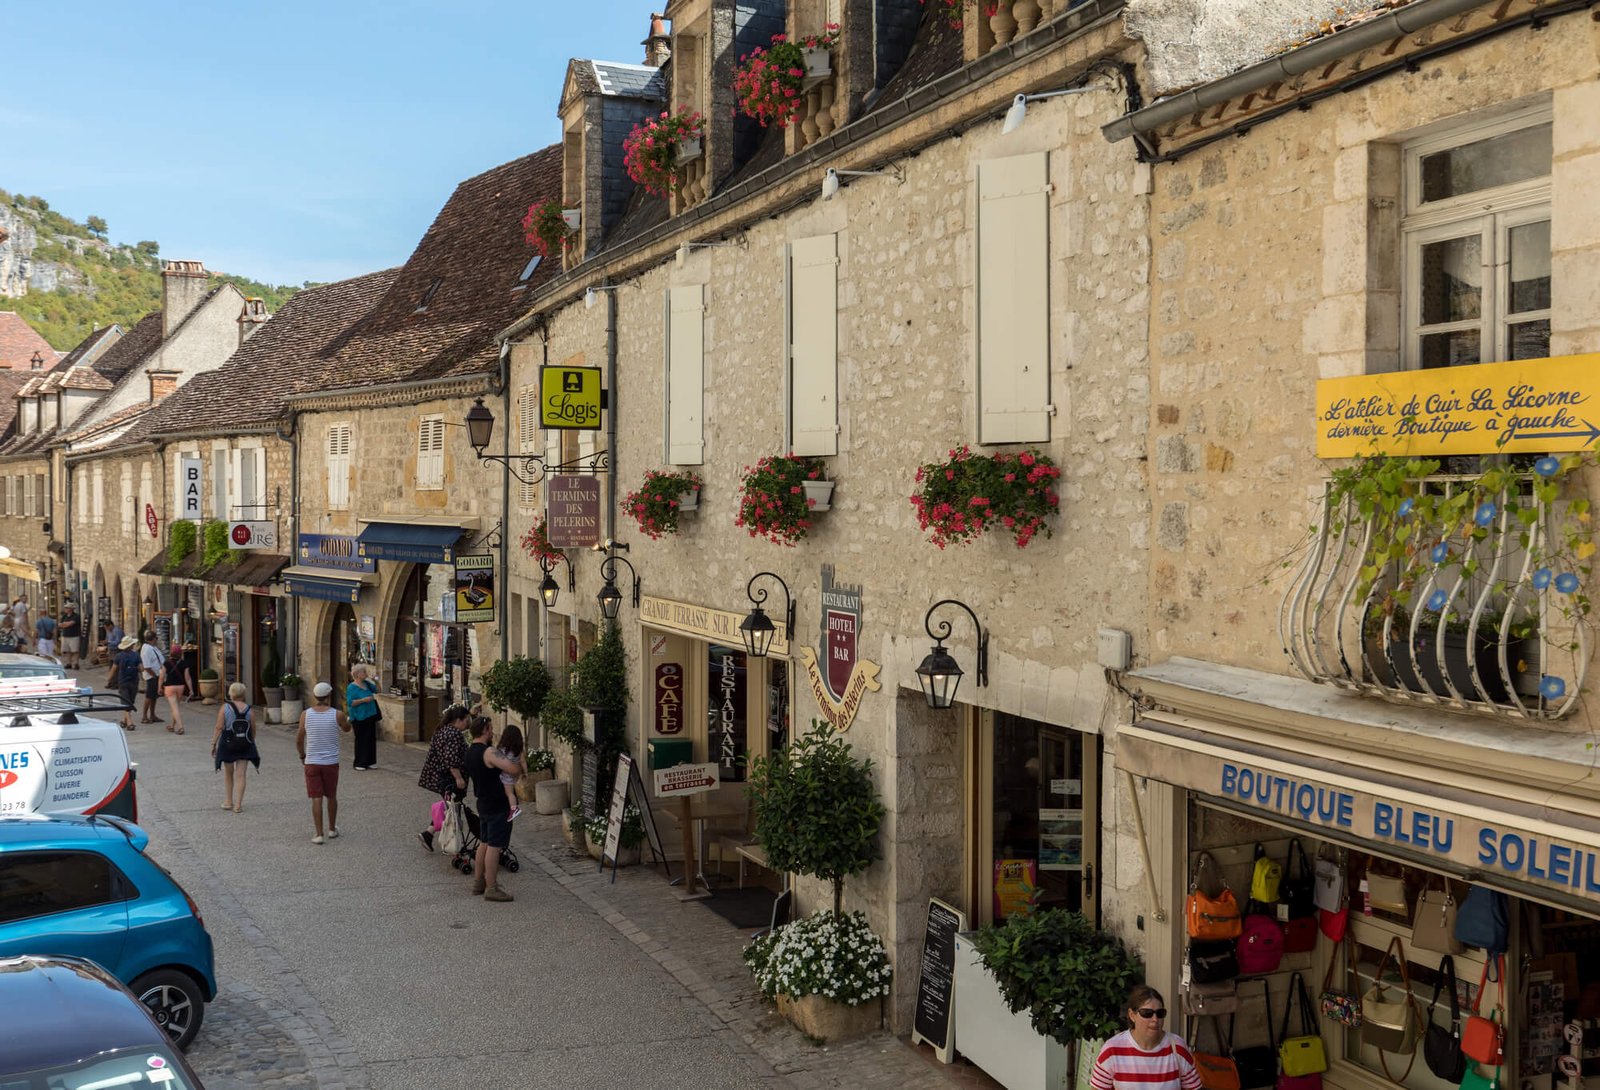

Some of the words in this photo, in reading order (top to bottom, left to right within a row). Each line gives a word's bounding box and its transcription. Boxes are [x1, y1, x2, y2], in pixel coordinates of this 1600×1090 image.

[547, 393, 598, 424] Logis
[1325, 395, 1397, 421] L'atelier
[1401, 400, 1420, 418] de
[1425, 390, 1464, 415] Cuir
[1467, 387, 1497, 411] La
[1502, 384, 1592, 411] Licorne
[1392, 415, 1478, 443] Boutique
[1485, 412, 1503, 431] à
[1500, 408, 1584, 443] gauche
[187, 467, 198, 510] BAR
[568, 477, 580, 489] LE
[551, 490, 598, 502] TERMINUS
[566, 503, 583, 514] DES
[553, 516, 596, 528] PELERINS
[320, 537, 353, 557] GODARD
[457, 556, 492, 567] GODARD
[822, 592, 860, 610] RESTAURANT
[642, 598, 671, 620] GRANDE
[673, 605, 709, 630] TERRASSE
[713, 613, 729, 635] SUR
[829, 617, 854, 633] HOTEL
[834, 646, 849, 662] BAR
[808, 660, 816, 680] Le
[812, 678, 838, 727] Terminus
[837, 713, 848, 730] des
[658, 675, 681, 732] CAFE
[721, 655, 735, 768] RESTAURANT
[51, 746, 71, 755] FROID
[54, 755, 103, 767] CLIMATISATION
[55, 768, 84, 778] CUISSON
[664, 768, 706, 779] RESTAURANT
[668, 774, 703, 784] BRASSERIE
[55, 780, 81, 790] LAVERIE
[675, 779, 707, 790] terrasse
[52, 791, 91, 802] BUANDERIE
[15, 801, 26, 810] 78
[1221, 764, 1354, 827] BOUTIQUE
[1374, 801, 1454, 854] BLEU
[1478, 827, 1600, 893] SOLEIL
